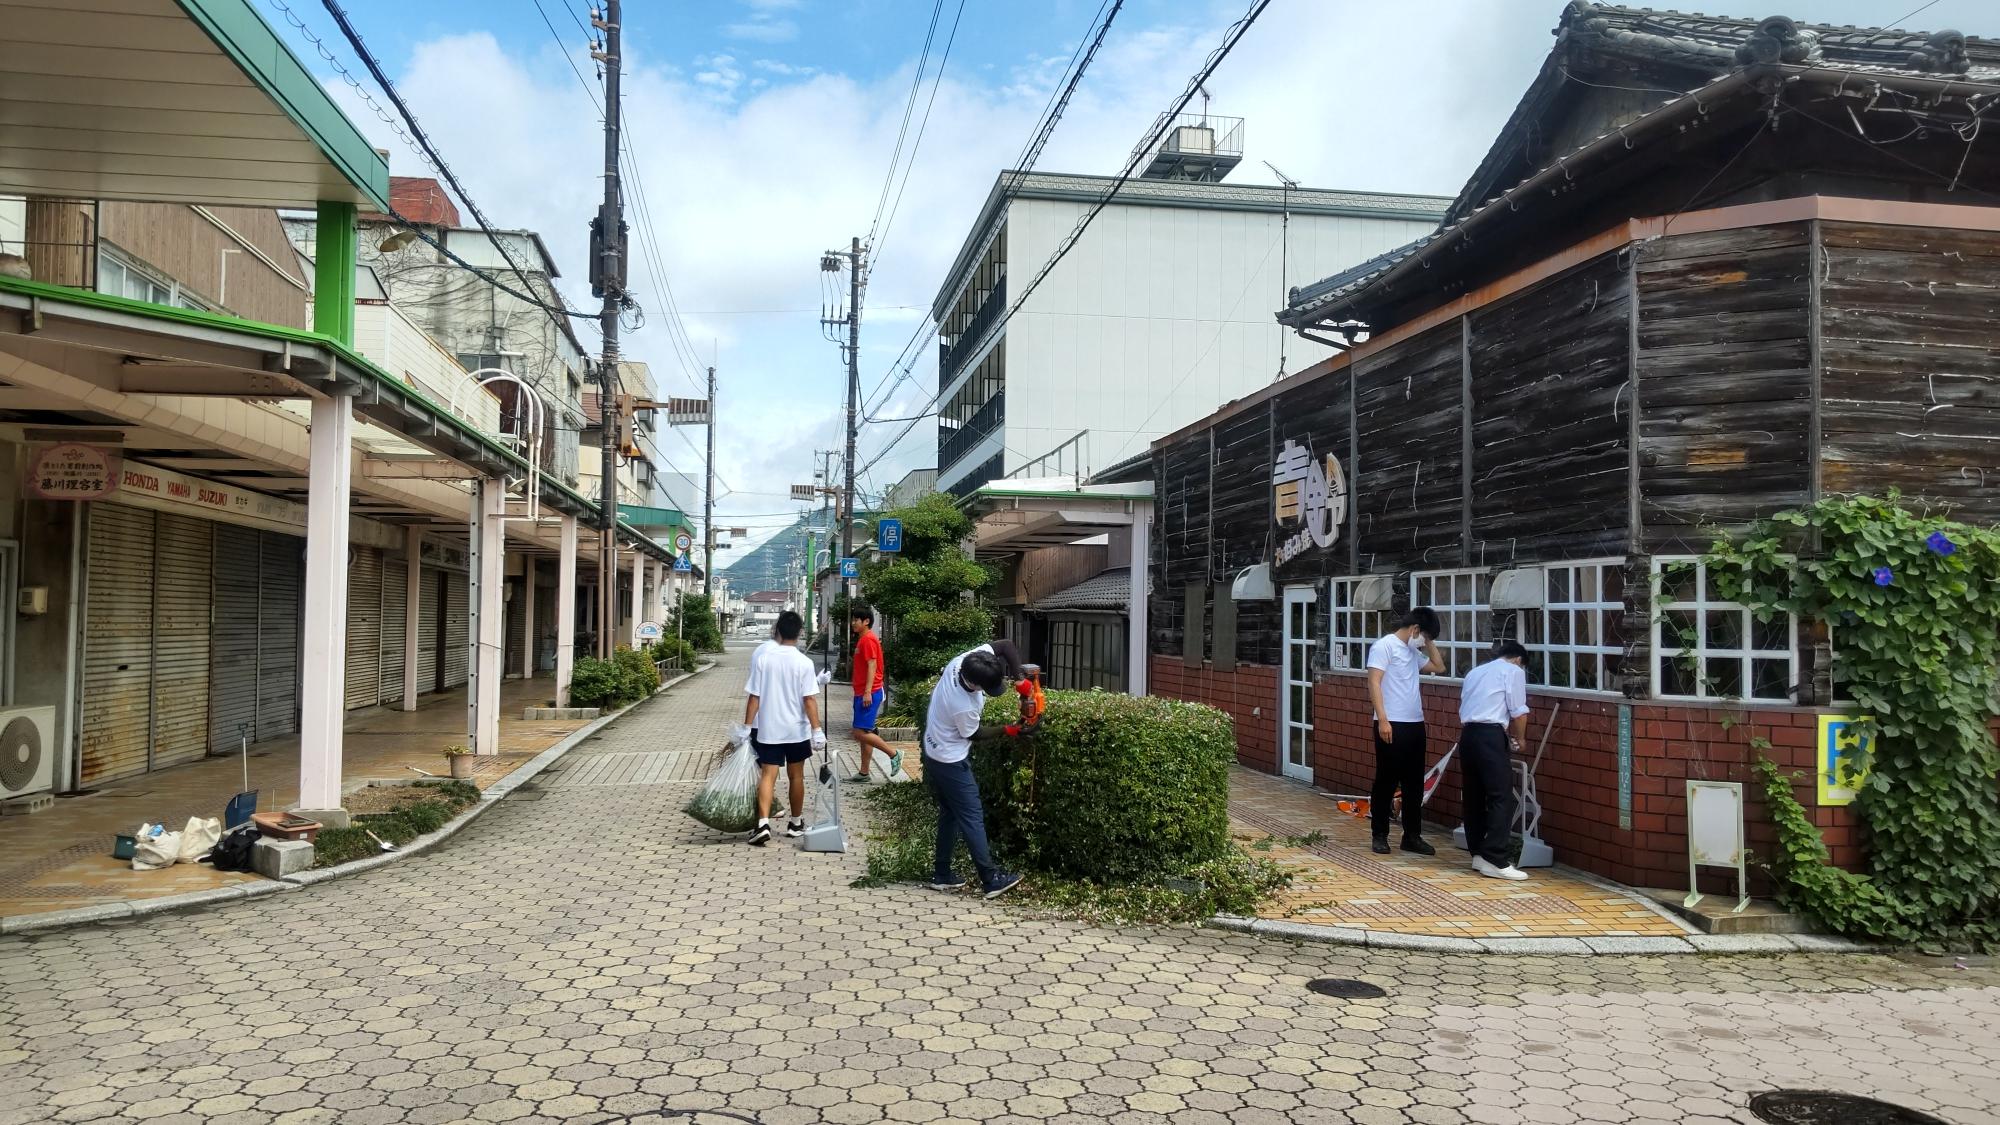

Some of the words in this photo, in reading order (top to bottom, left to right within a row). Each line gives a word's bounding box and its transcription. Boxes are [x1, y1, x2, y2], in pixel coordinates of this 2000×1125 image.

[40, 477, 103, 491] 藤川理容室
[123, 470, 159, 492] HONDA
[167, 480, 191, 498] YAMAHA
[198, 489, 228, 507] SUZUKI
[679, 538, 688, 547] 30
[882, 525, 898, 546] 停
[844, 562, 857, 574] 停
[1827, 721, 1869, 786] P
